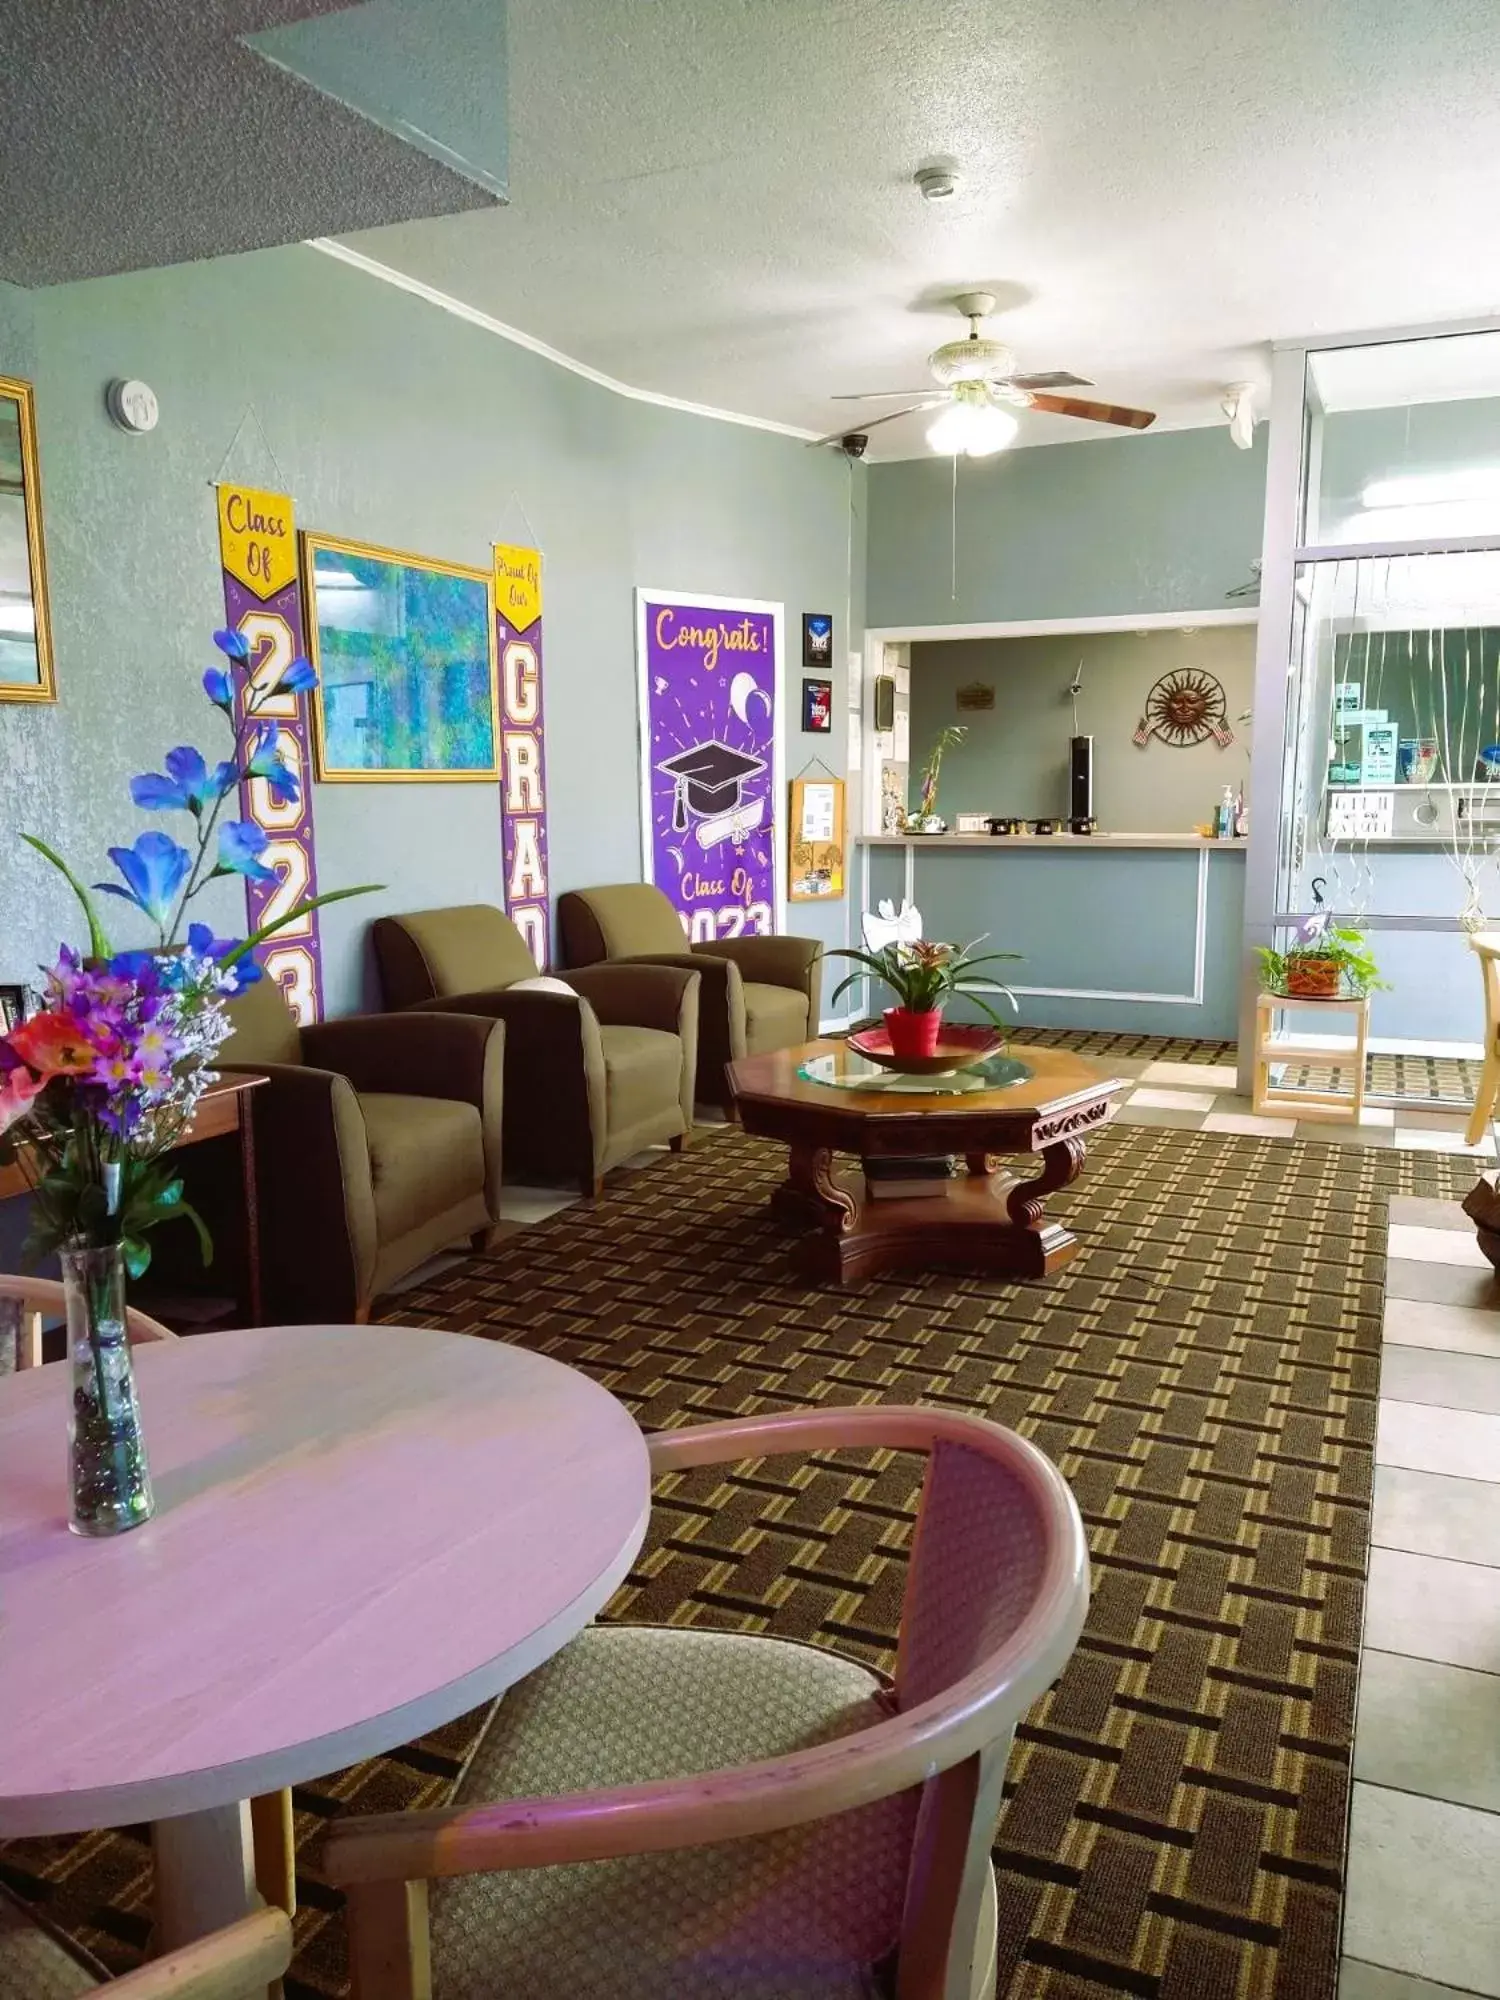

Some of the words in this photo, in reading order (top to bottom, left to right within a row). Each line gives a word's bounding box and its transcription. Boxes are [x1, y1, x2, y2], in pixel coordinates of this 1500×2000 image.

[226, 493, 287, 537] Class
[247, 541, 273, 583] Of
[496, 556, 526, 580] Proud
[528, 562, 539, 593] Of
[509, 584, 528, 607] Our
[655, 608, 768, 671] Congrats!
[681, 871, 726, 901] Class
[731, 867, 754, 906] Of
